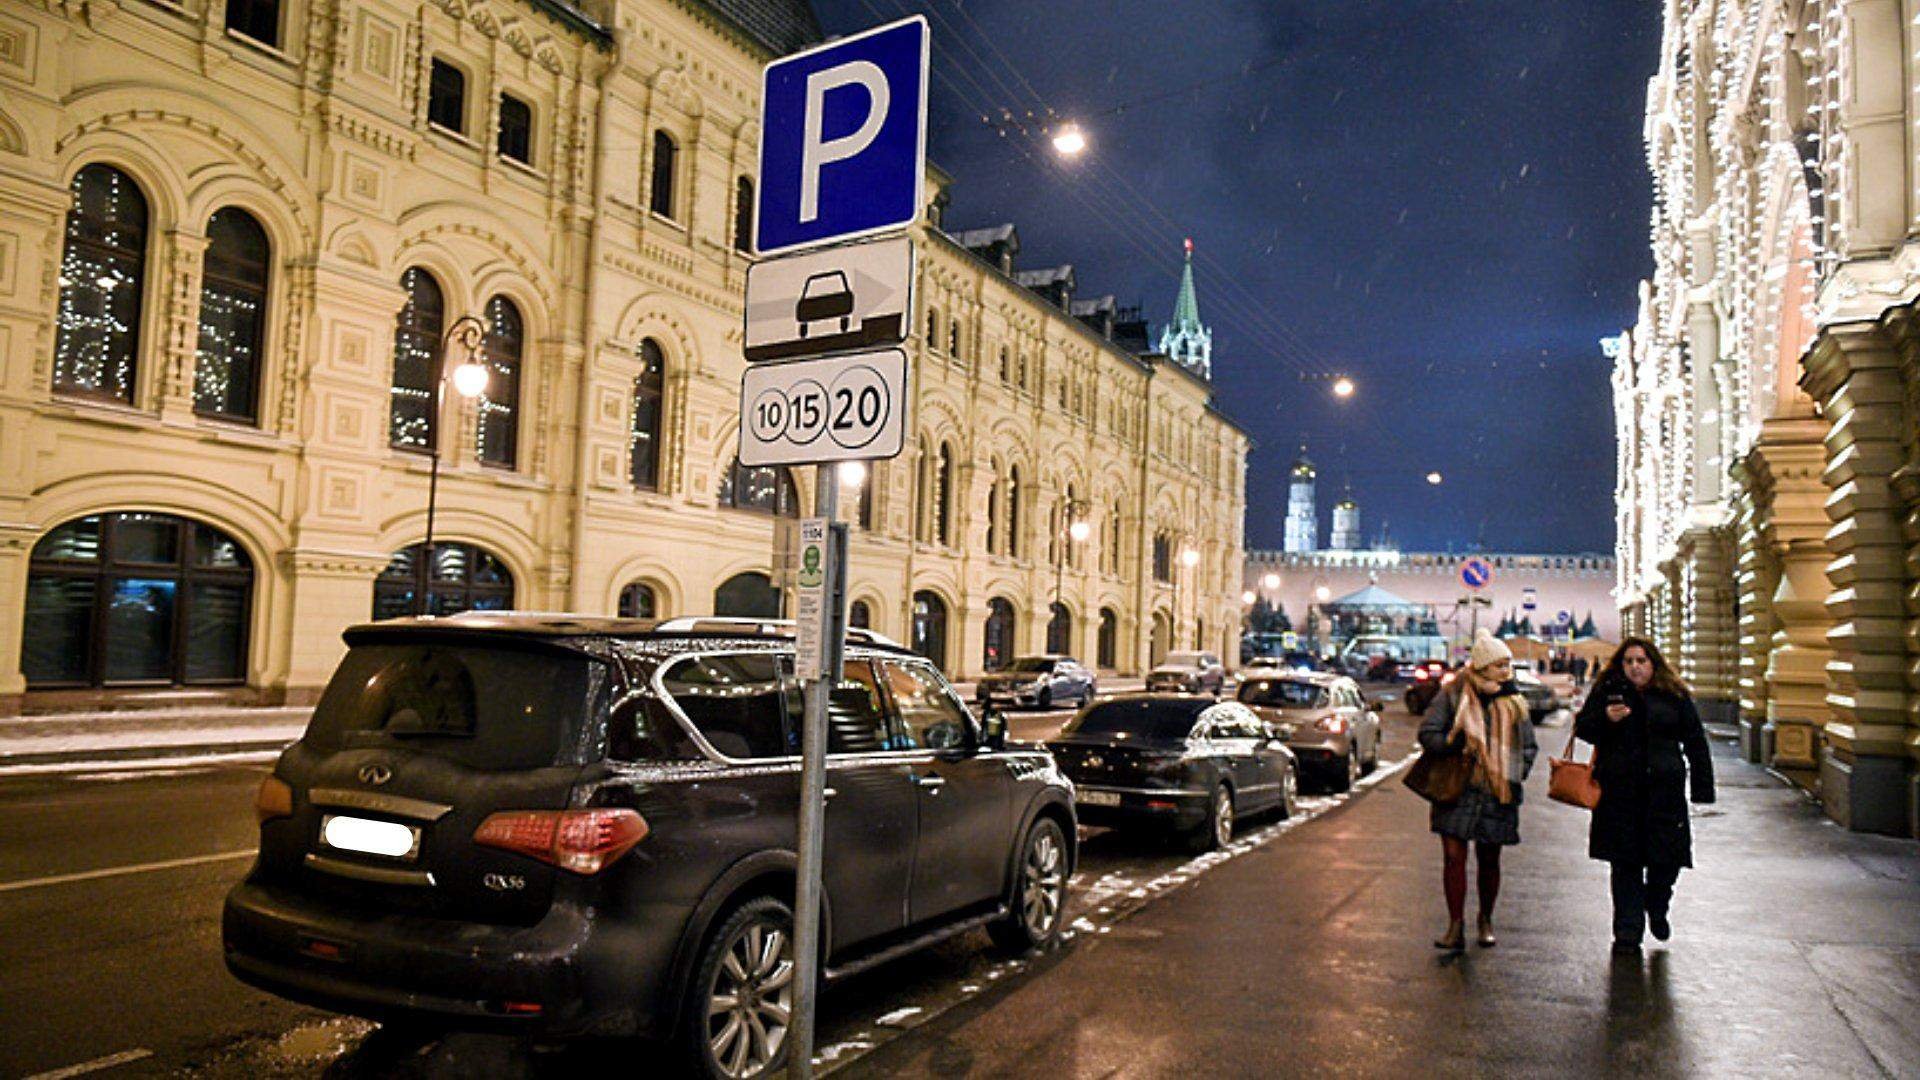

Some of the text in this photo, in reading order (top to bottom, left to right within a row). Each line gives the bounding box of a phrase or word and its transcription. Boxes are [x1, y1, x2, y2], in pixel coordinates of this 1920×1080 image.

[800, 60, 890, 222] P
[758, 386, 880, 430] 10 15 20
[483, 873, 526, 890] QX56
